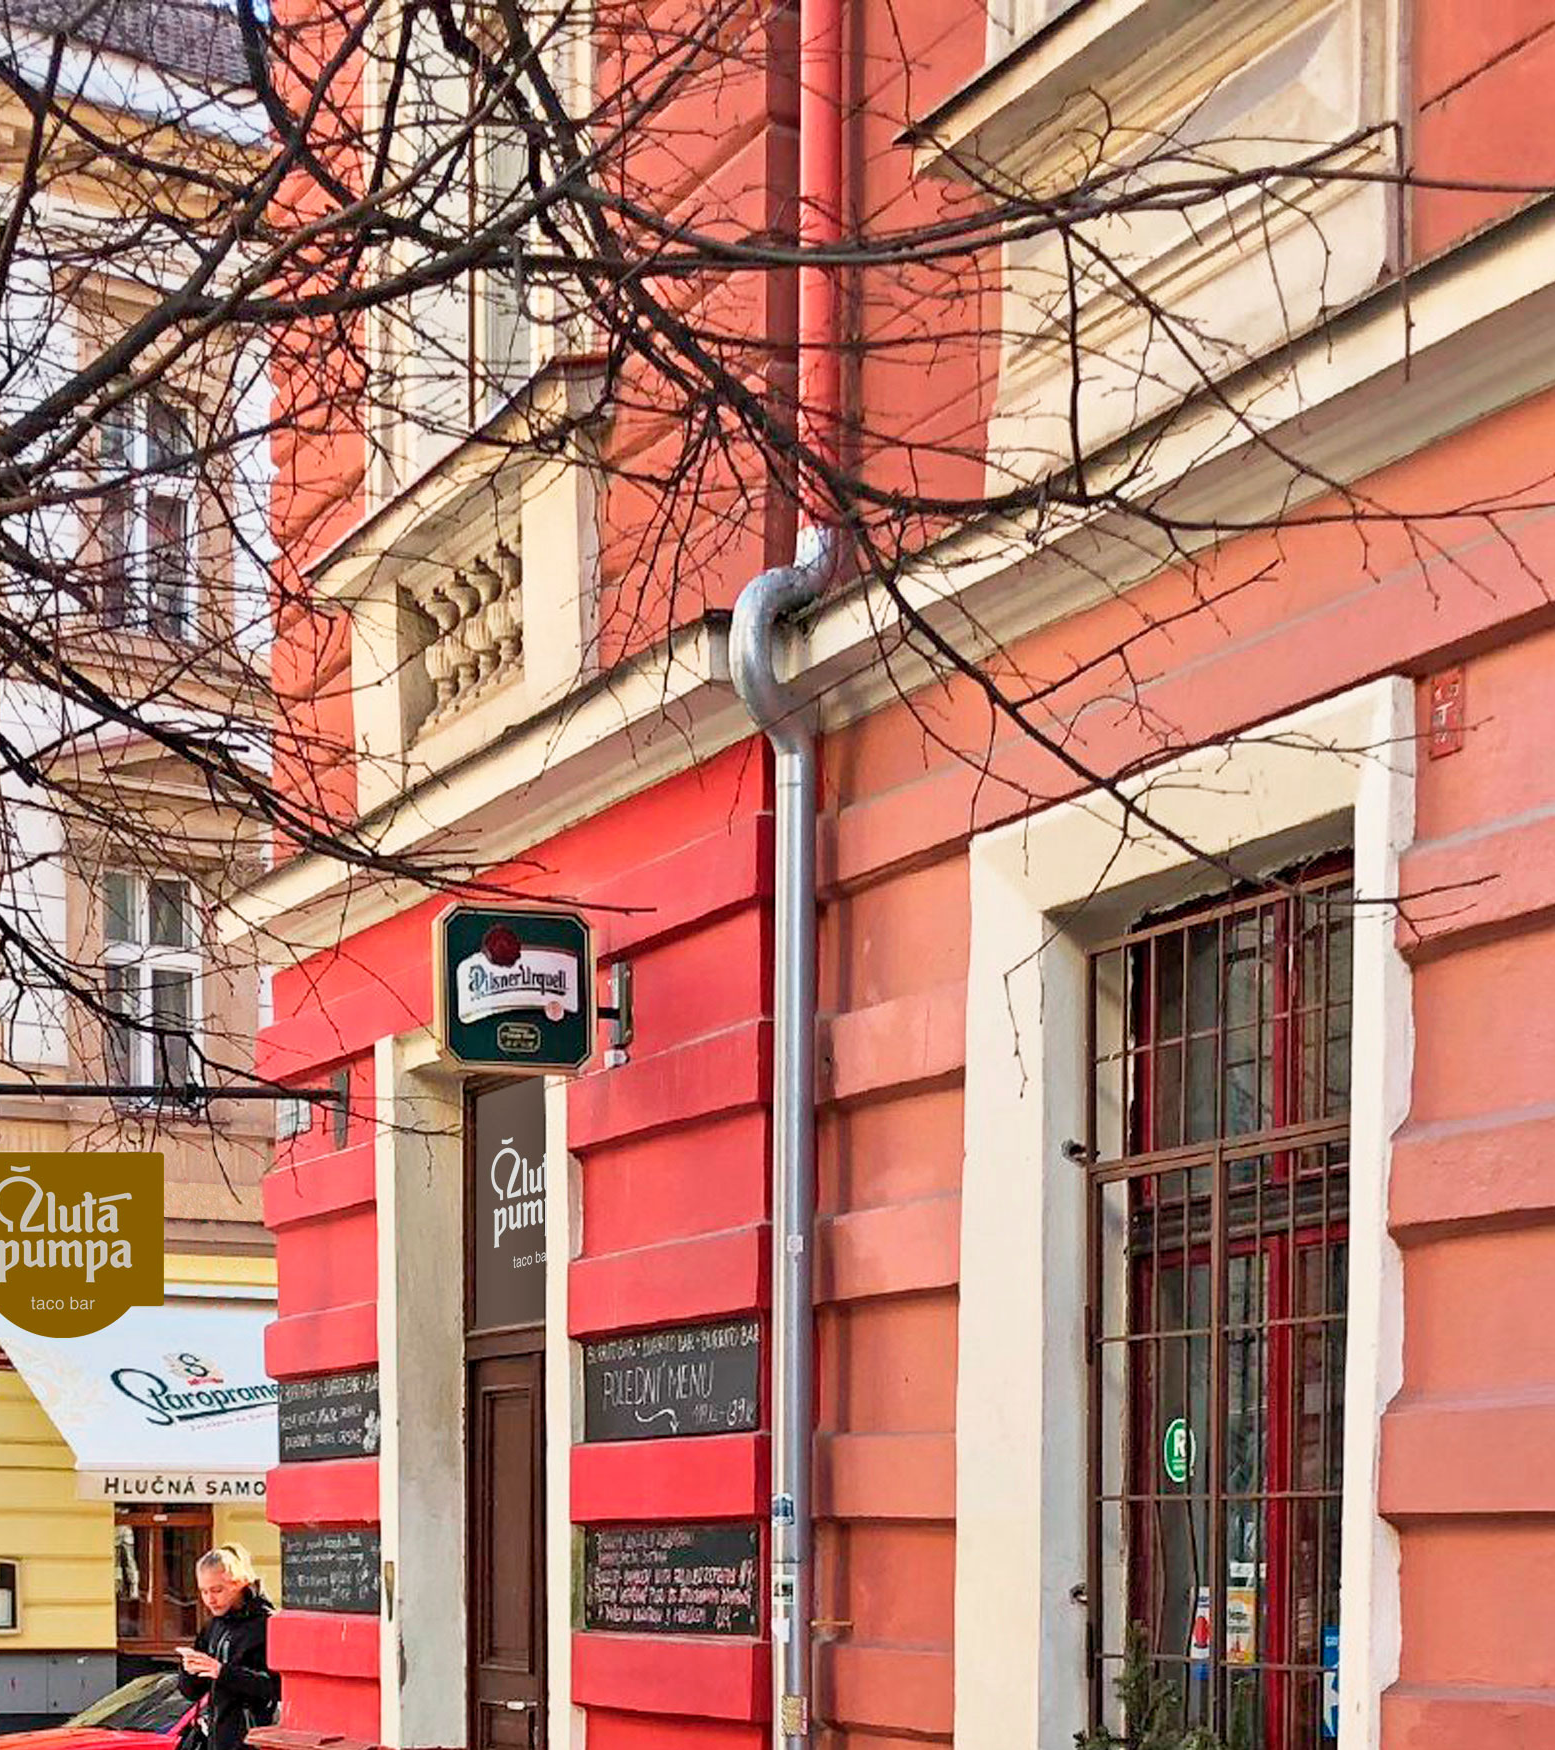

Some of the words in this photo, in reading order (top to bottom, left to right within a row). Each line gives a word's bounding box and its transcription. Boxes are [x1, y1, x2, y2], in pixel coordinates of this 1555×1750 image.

[512, 1255, 533, 1269] taco
[31, 1297, 65, 1311] taco
[70, 1296, 96, 1311] bar
[104, 1476, 196, 1495] HLUČNÁ
